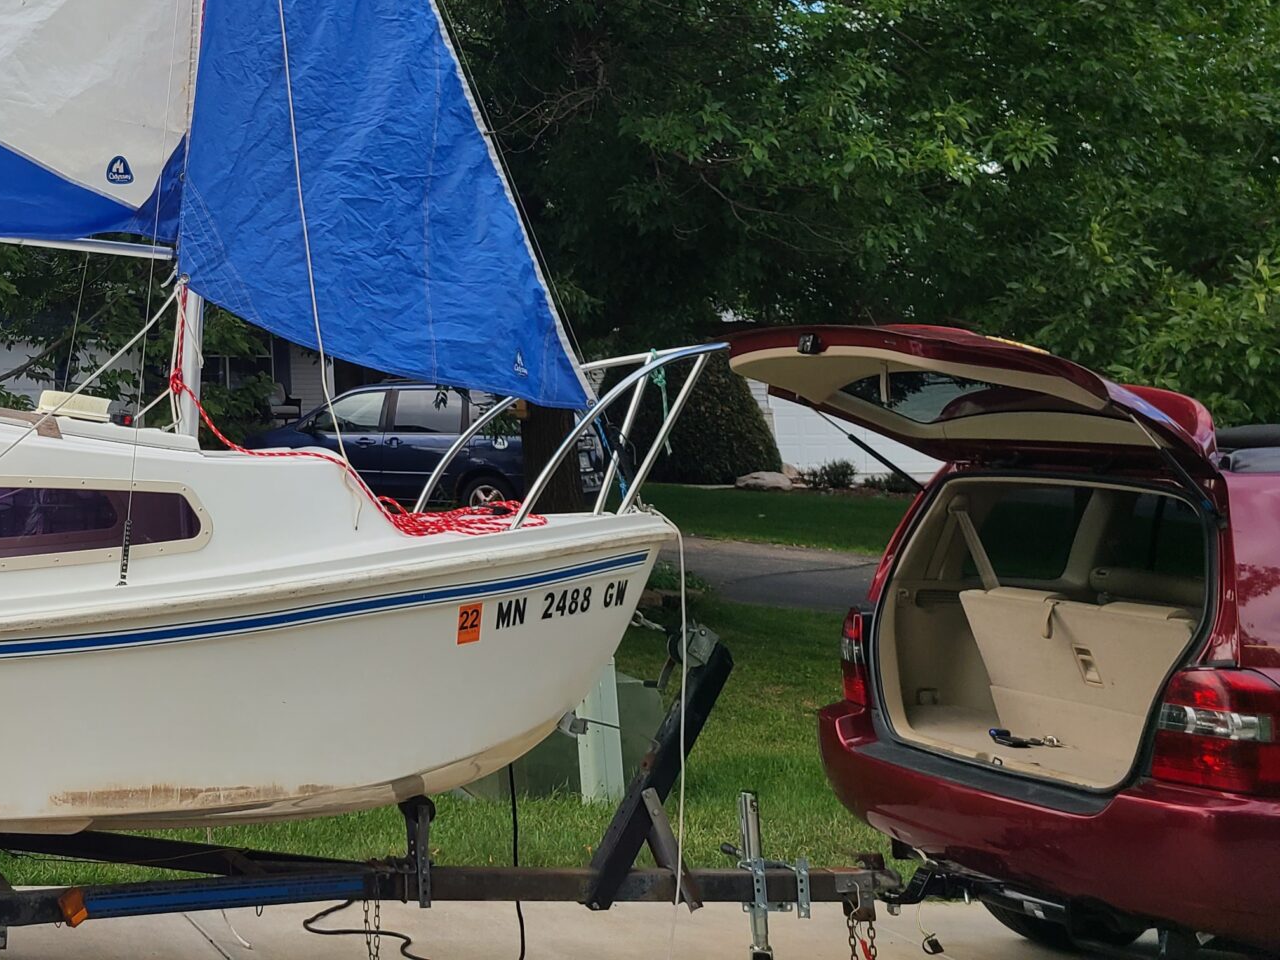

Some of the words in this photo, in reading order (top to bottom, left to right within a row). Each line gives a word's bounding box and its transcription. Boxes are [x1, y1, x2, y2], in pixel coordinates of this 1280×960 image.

[459, 608, 480, 631] 22
[496, 597, 528, 630] MN
[541, 587, 592, 620] 2488
[603, 579, 629, 608] GW
